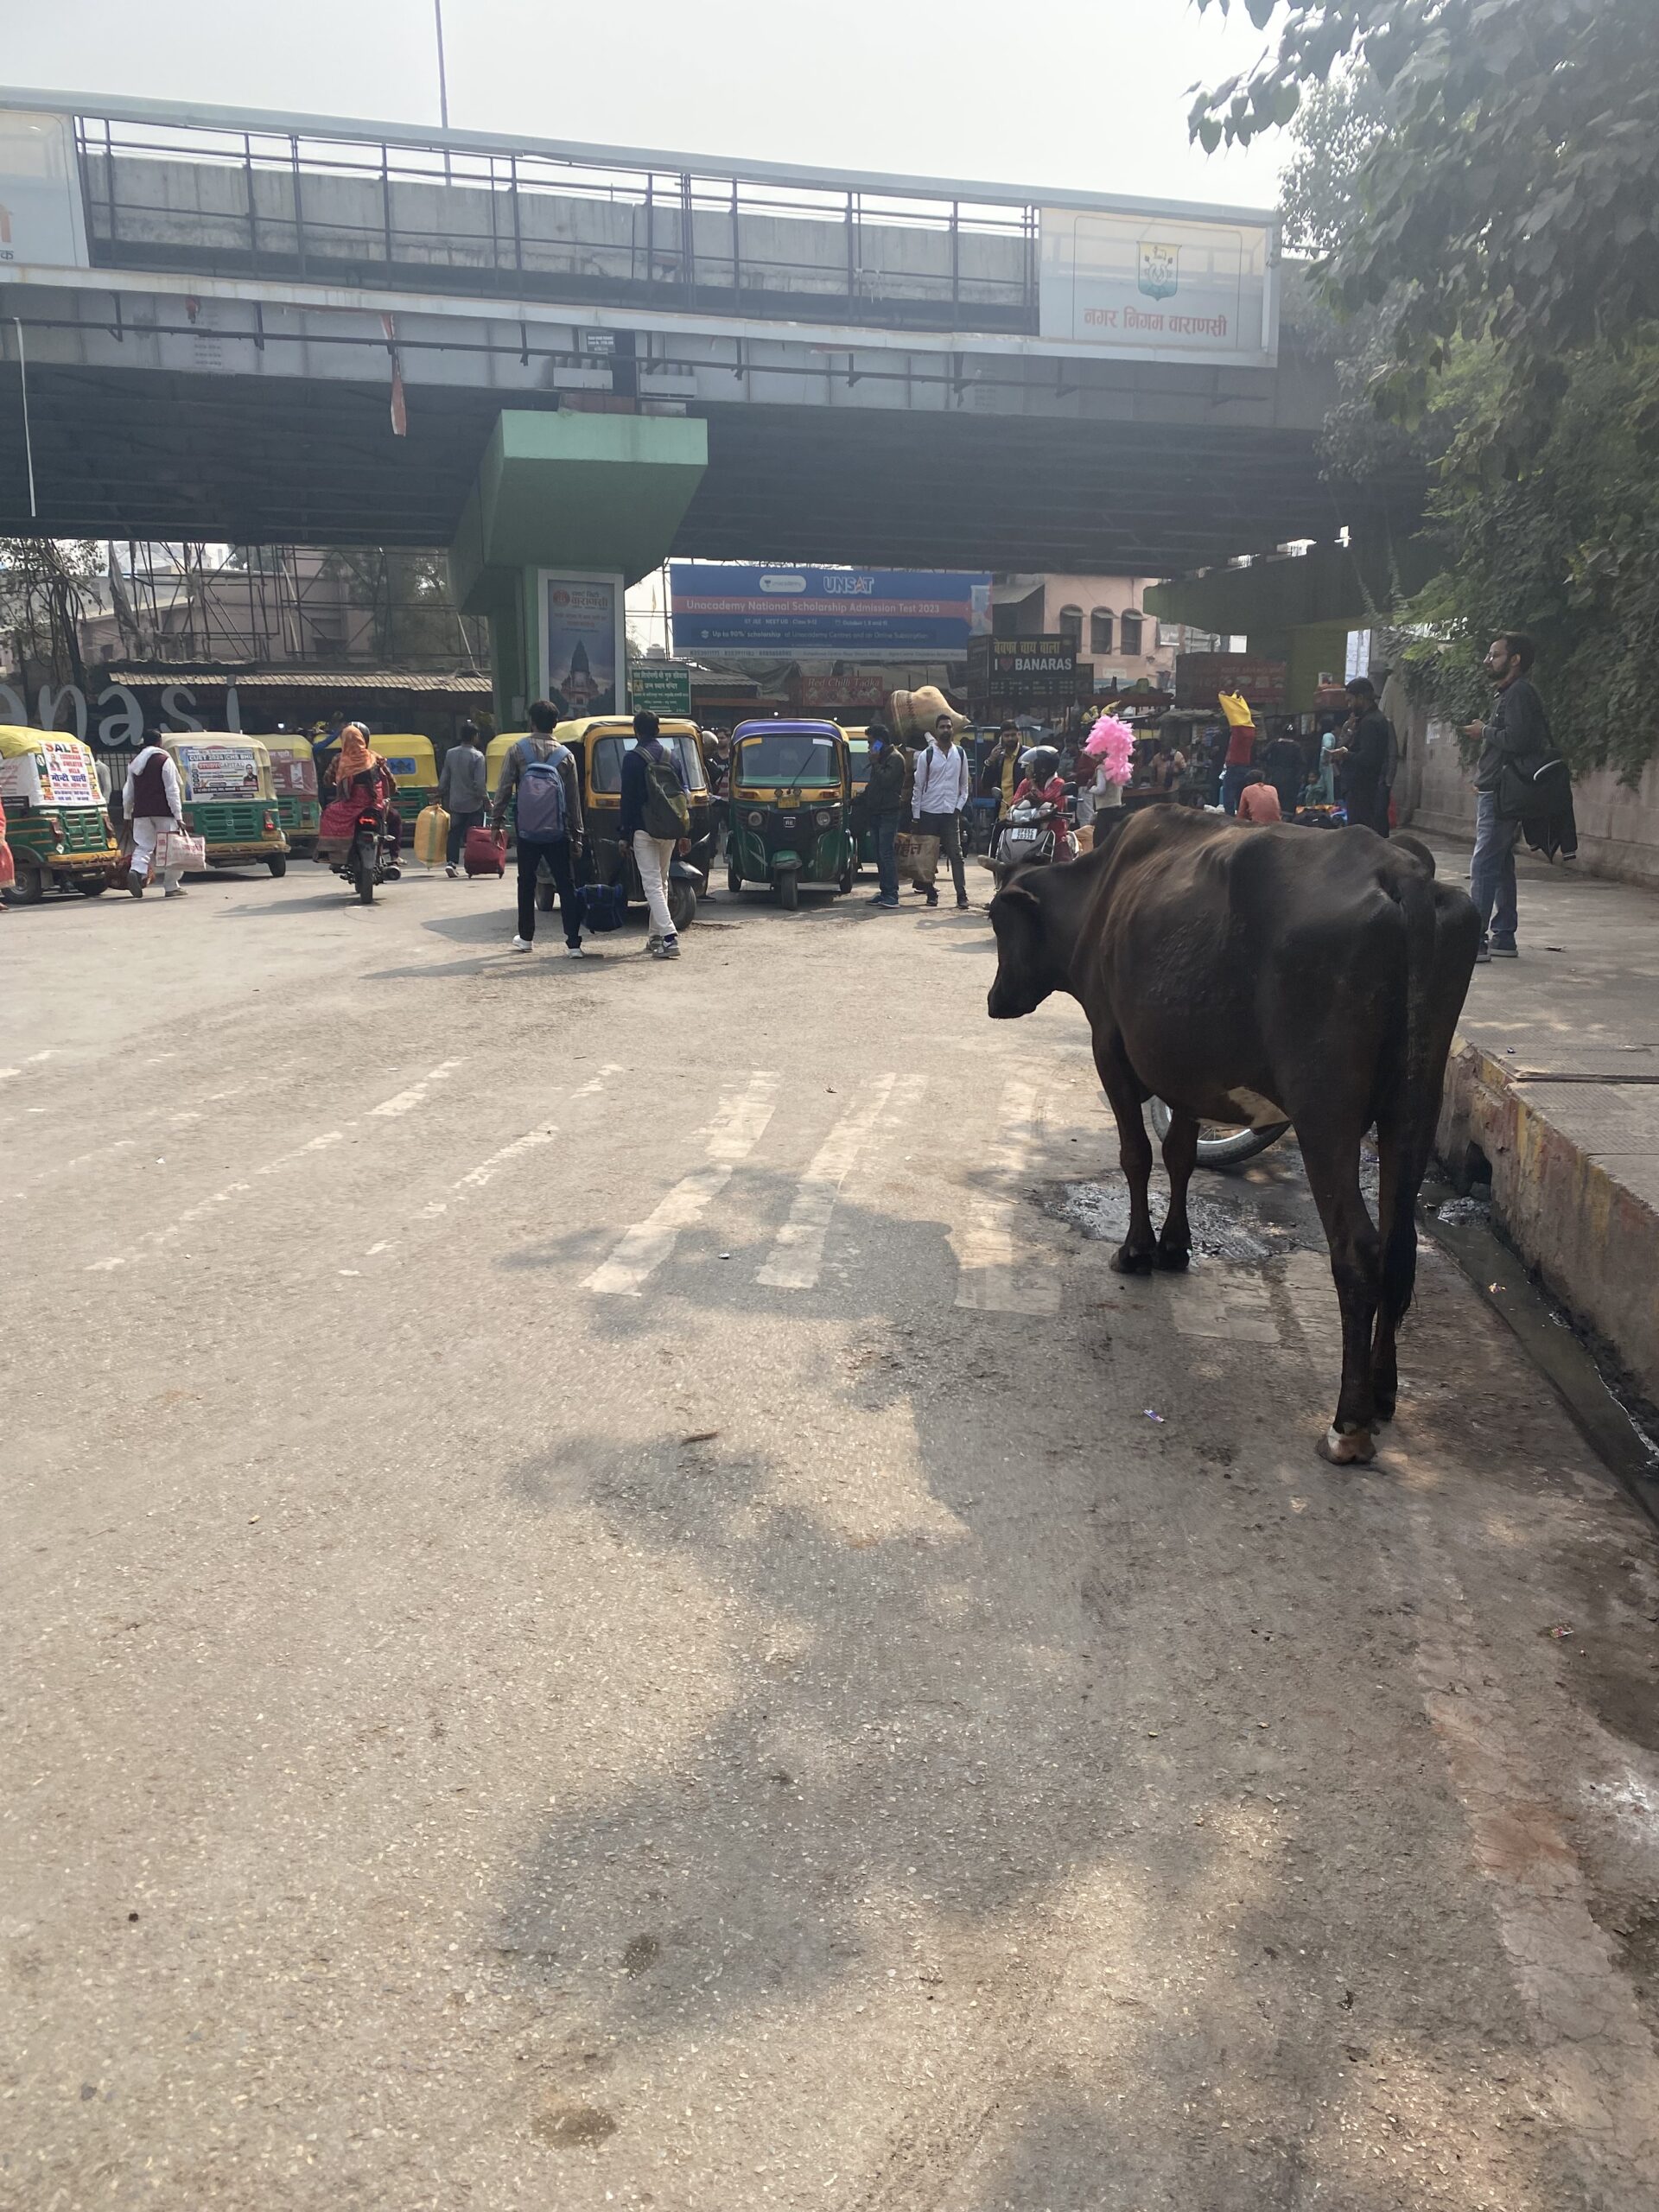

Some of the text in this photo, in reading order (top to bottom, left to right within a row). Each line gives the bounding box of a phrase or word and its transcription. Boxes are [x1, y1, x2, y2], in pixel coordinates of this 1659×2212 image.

[1083, 305, 1227, 337] नगर निगम वाराणसी
[823, 576, 874, 594] UNSAT
[687, 600, 940, 613] Unacademy National Scholarship Admission Test 2023
[712, 629, 721, 638] Up
[747, 630, 780, 639] scholarship
[995, 658, 1072, 671] I BANARAS
[809, 677, 880, 687] Red Chilli Tadka
[45, 742, 79, 754] SALE
